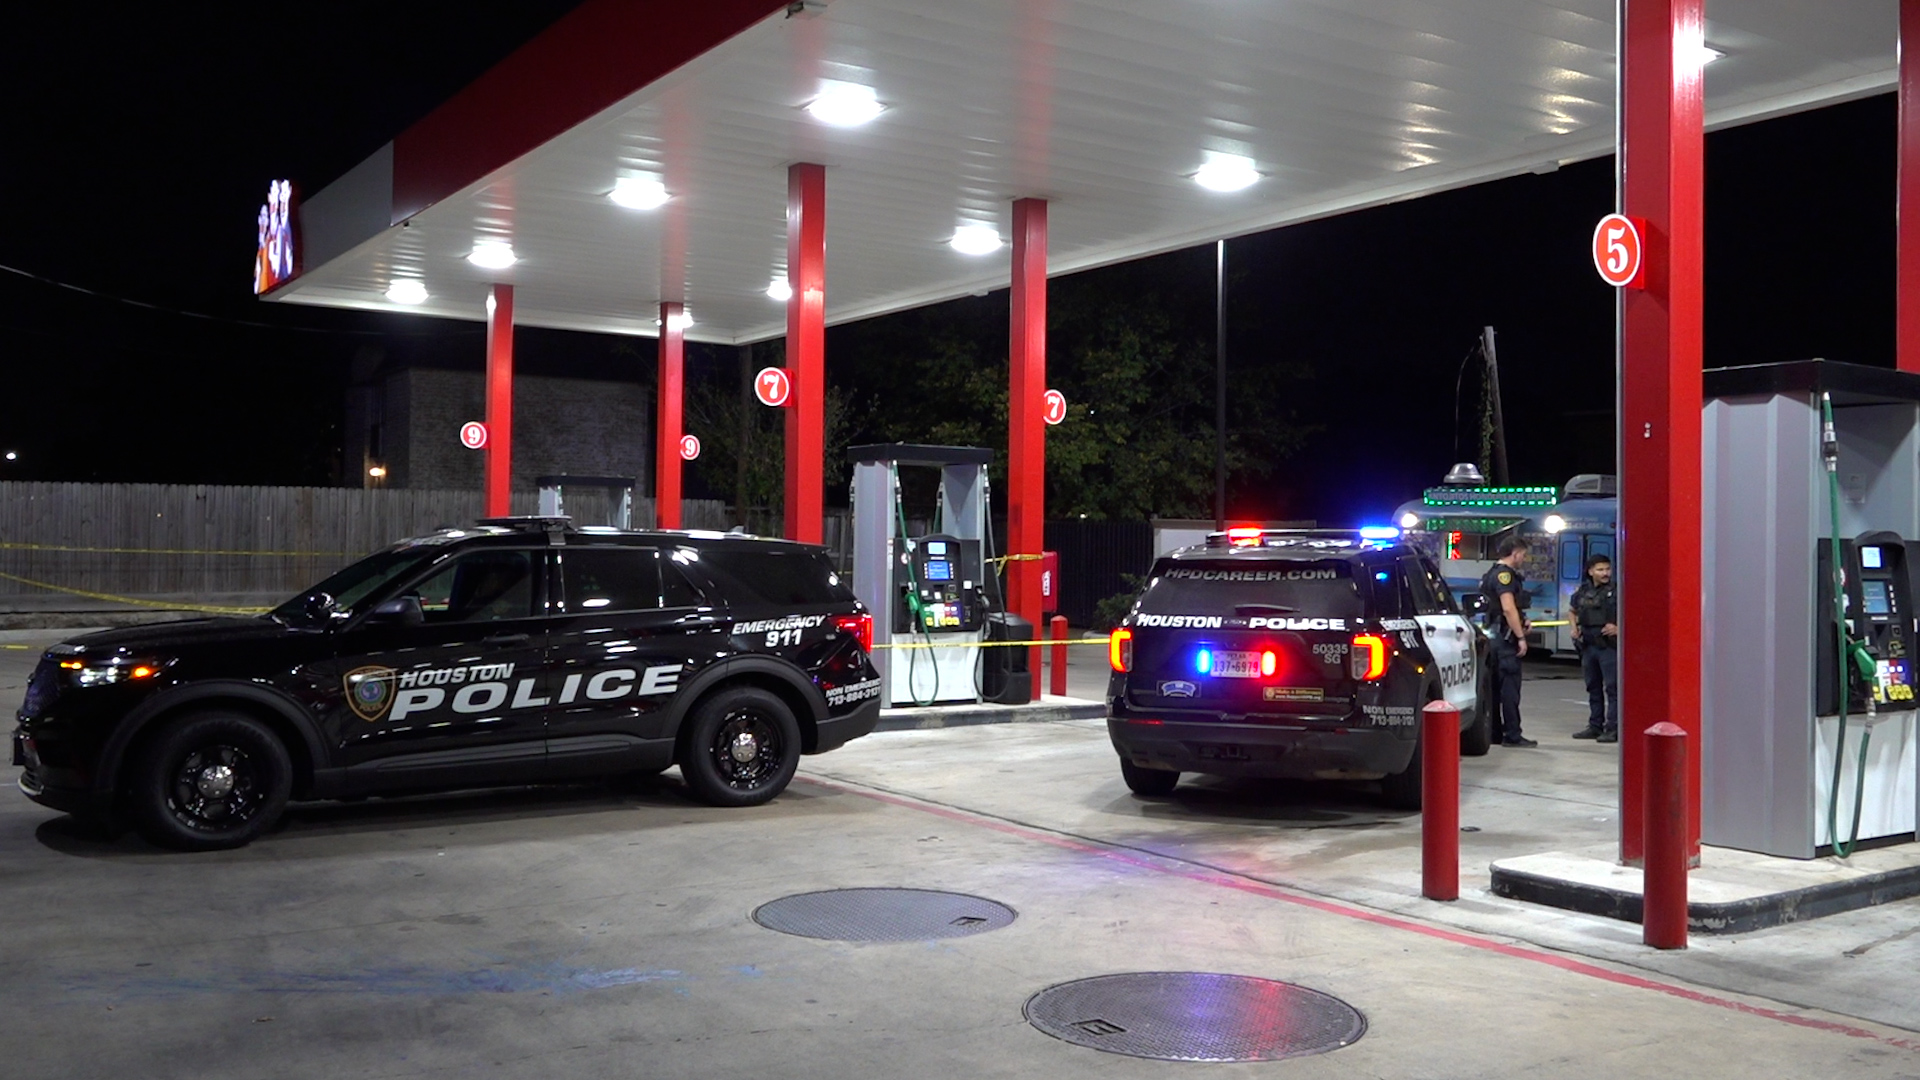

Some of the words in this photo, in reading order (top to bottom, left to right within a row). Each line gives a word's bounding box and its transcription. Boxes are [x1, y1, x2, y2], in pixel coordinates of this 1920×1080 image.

[1607, 226, 1628, 273] 5
[763, 374, 780, 399] 7
[1047, 395, 1060, 418] 7
[467, 426, 480, 444] 9
[685, 439, 695, 455] 9
[1165, 568, 1337, 581] HPDCAREER.COM
[732, 615, 826, 635] EMERGENCY
[1137, 613, 1222, 628] HOUSTON
[1249, 617, 1346, 630] POLICE
[765, 629, 803, 648] 911
[1400, 631, 1419, 648] 911
[1312, 644, 1349, 654] 50335
[1324, 654, 1341, 664] SG
[400, 663, 515, 688] HOUSTON
[1442, 662, 1471, 688] POLICE
[388, 664, 684, 721] POLICE
[825, 687, 843, 698] NON
[844, 678, 881, 693] EMERGENC
[1363, 705, 1384, 714] NON
